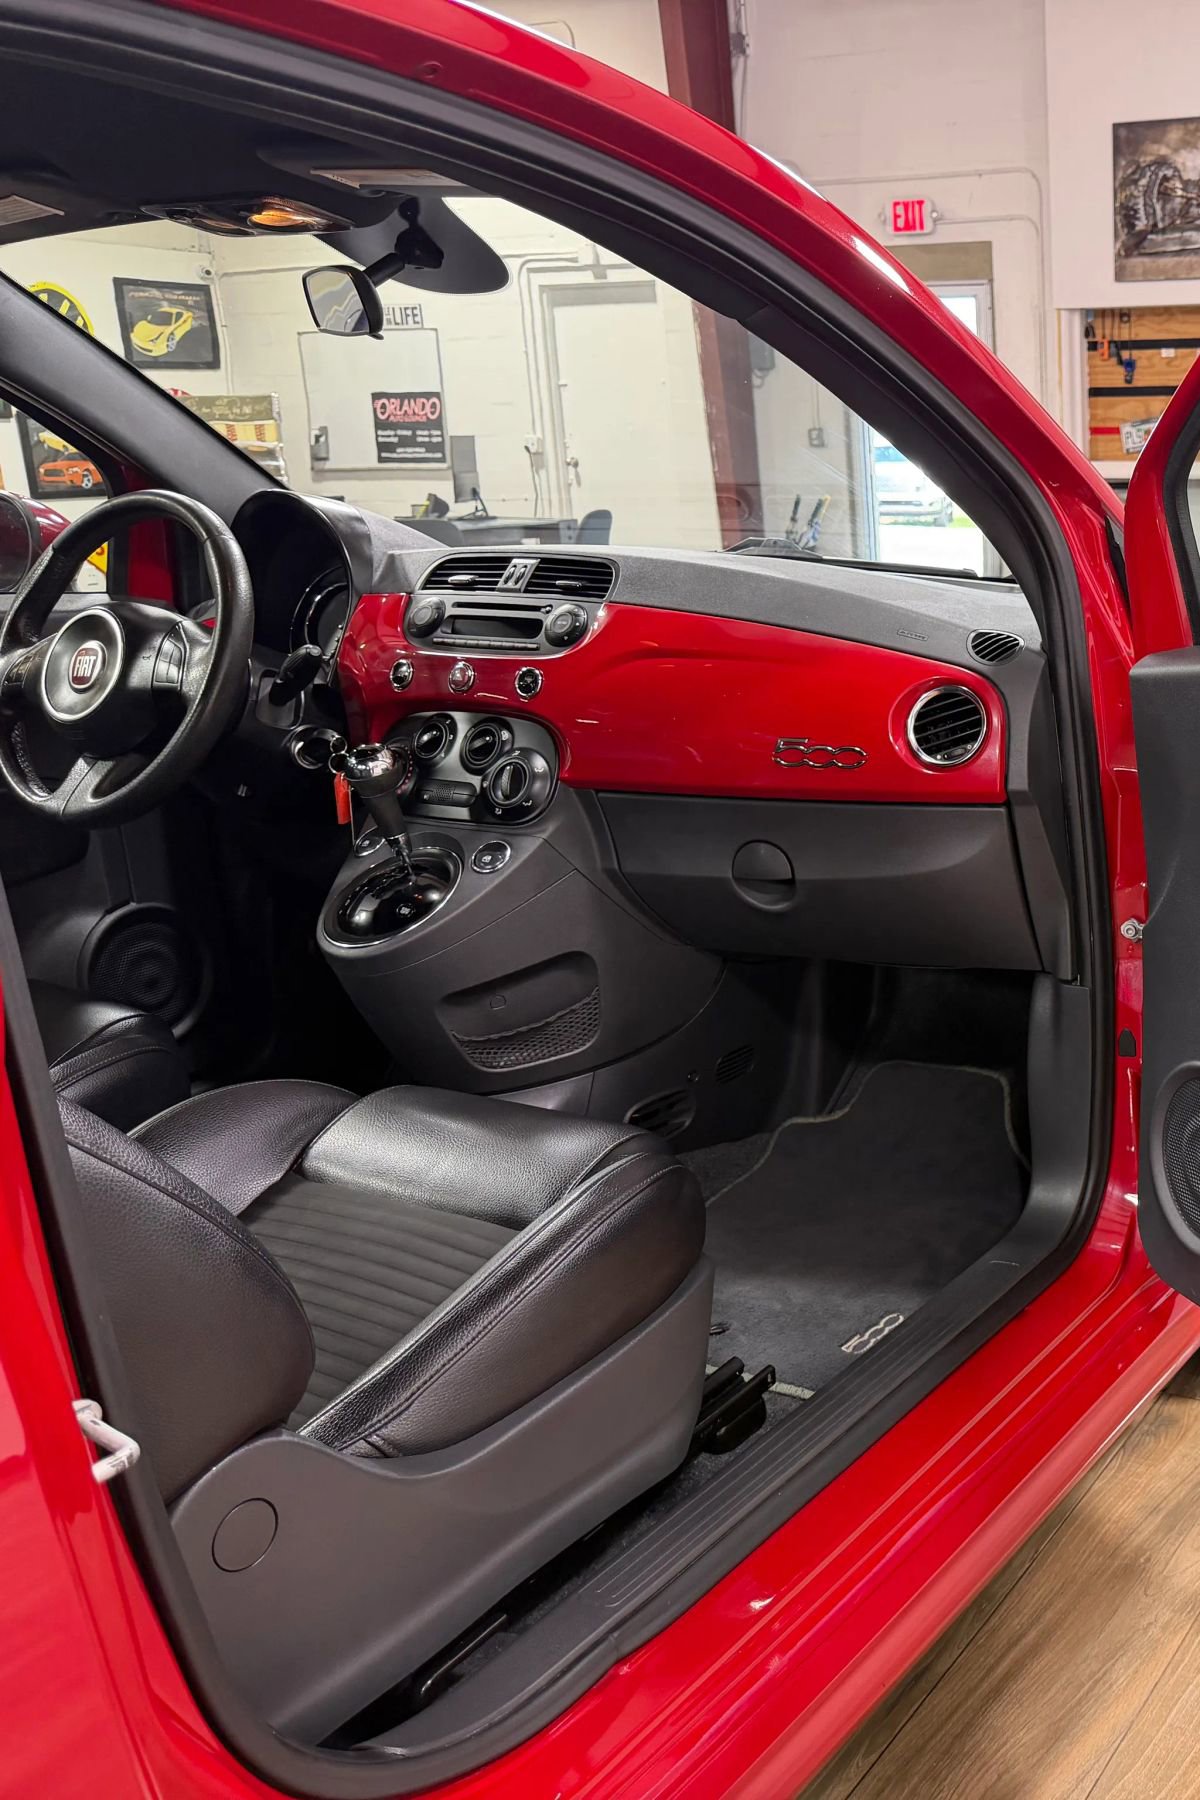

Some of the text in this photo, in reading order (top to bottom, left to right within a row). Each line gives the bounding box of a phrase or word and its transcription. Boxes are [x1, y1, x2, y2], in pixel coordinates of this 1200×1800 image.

[892, 199, 925, 232] EXIT
[391, 306, 420, 326] LIFE
[376, 397, 441, 420] ORLANDO
[73, 655, 97, 677] FIAT
[771, 737, 868, 769] 500
[841, 1312, 904, 1355] 500
